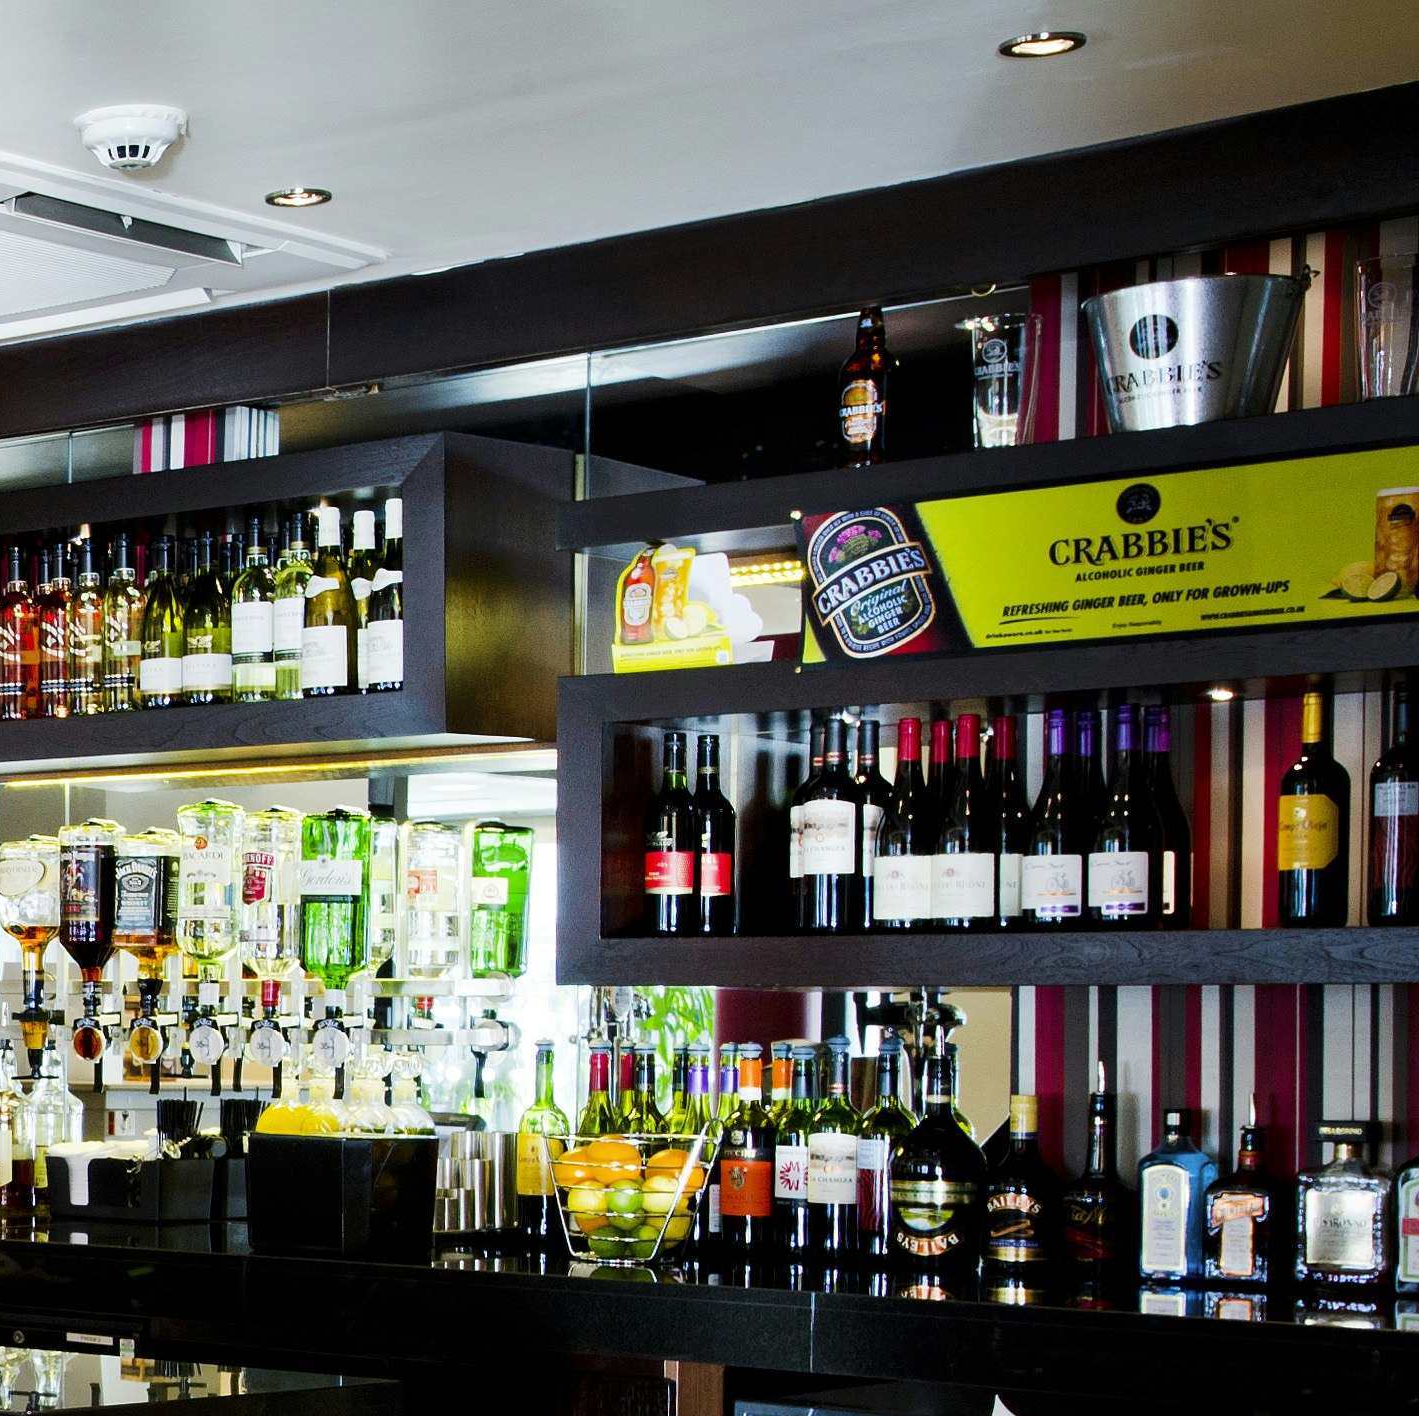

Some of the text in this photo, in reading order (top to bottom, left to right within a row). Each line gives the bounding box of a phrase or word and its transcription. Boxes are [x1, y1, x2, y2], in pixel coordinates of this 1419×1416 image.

[818, 547, 926, 614] CRABBIE'S
[1075, 561, 1205, 582] ALCOHOLIC GINGER BEER
[851, 578, 910, 616] Original
[1002, 580, 1290, 616] REFRESHING GINGER BEER, ONLY FOR GROWN-UPS
[859, 595, 908, 625] ALCOHOLIC
[868, 607, 904, 628] GINGER
[877, 617, 901, 634] BEER
[183, 852, 223, 860] BACARDI
[303, 866, 352, 886] Gordon's
[987, 1192, 1042, 1214] BAILEYS
[896, 1231, 960, 1254] BAILEYS
